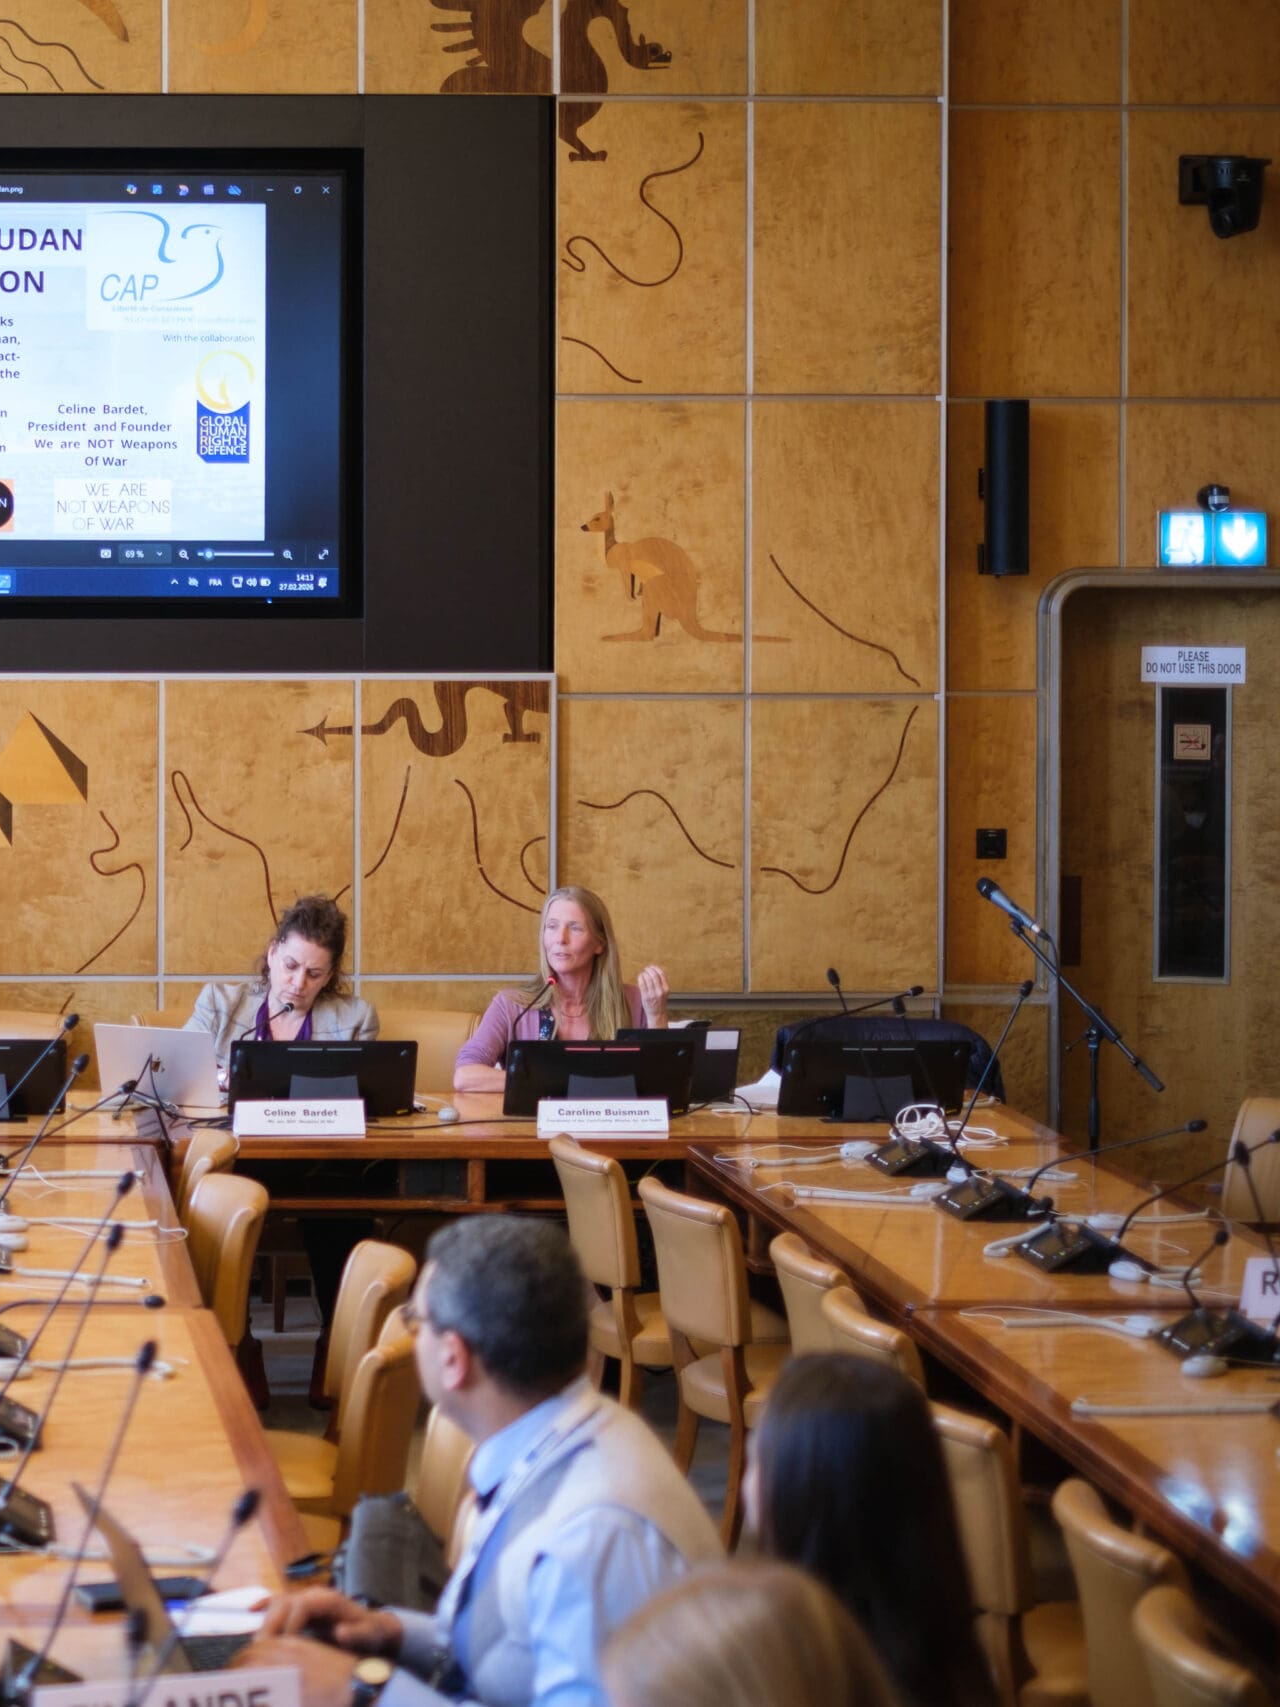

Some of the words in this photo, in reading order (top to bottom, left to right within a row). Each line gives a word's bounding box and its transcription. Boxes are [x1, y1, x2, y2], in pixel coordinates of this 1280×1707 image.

[100, 273, 159, 302] CAP
[162, 334, 183, 343] With
[184, 334, 199, 343] the
[200, 334, 256, 343] collaboration
[0, 368, 21, 379] the
[57, 404, 96, 415] Celine
[102, 404, 148, 416] Bardet,
[199, 416, 247, 426] GLOBAL
[27, 421, 87, 432] President
[93, 421, 117, 432] and
[120, 421, 172, 432] Founder
[200, 426, 247, 436] HUMAN
[34, 439, 54, 449] We
[60, 440, 81, 449] are
[87, 438, 115, 449] NOT
[120, 439, 178, 453] Weapons
[200, 436, 247, 446] RIGHTS
[200, 446, 247, 455] DEFENCE
[84, 456, 100, 467] Of
[102, 456, 128, 467] War
[84, 483, 110, 496] WE
[119, 483, 147, 496] ARE
[57, 500, 87, 513] NOT
[92, 500, 170, 514] WEAPONS
[72, 517, 94, 530] OF
[99, 517, 134, 530] WAR
[125, 550, 135, 558] 69
[296, 574, 314, 582] 14:13
[279, 583, 314, 591] 27.02.2026
[1178, 651, 1209, 661] PLEASE
[1146, 662, 1158, 673] DO
[1160, 662, 1176, 673] NOT
[1178, 663, 1195, 674] USE
[1198, 663, 1215, 674] THIS
[1218, 664, 1242, 675] DOOR
[264, 1109, 297, 1117] Celine
[303, 1109, 338, 1117] Bardet
[558, 1108, 602, 1116] Caroline
[605, 1108, 650, 1116] Buisman
